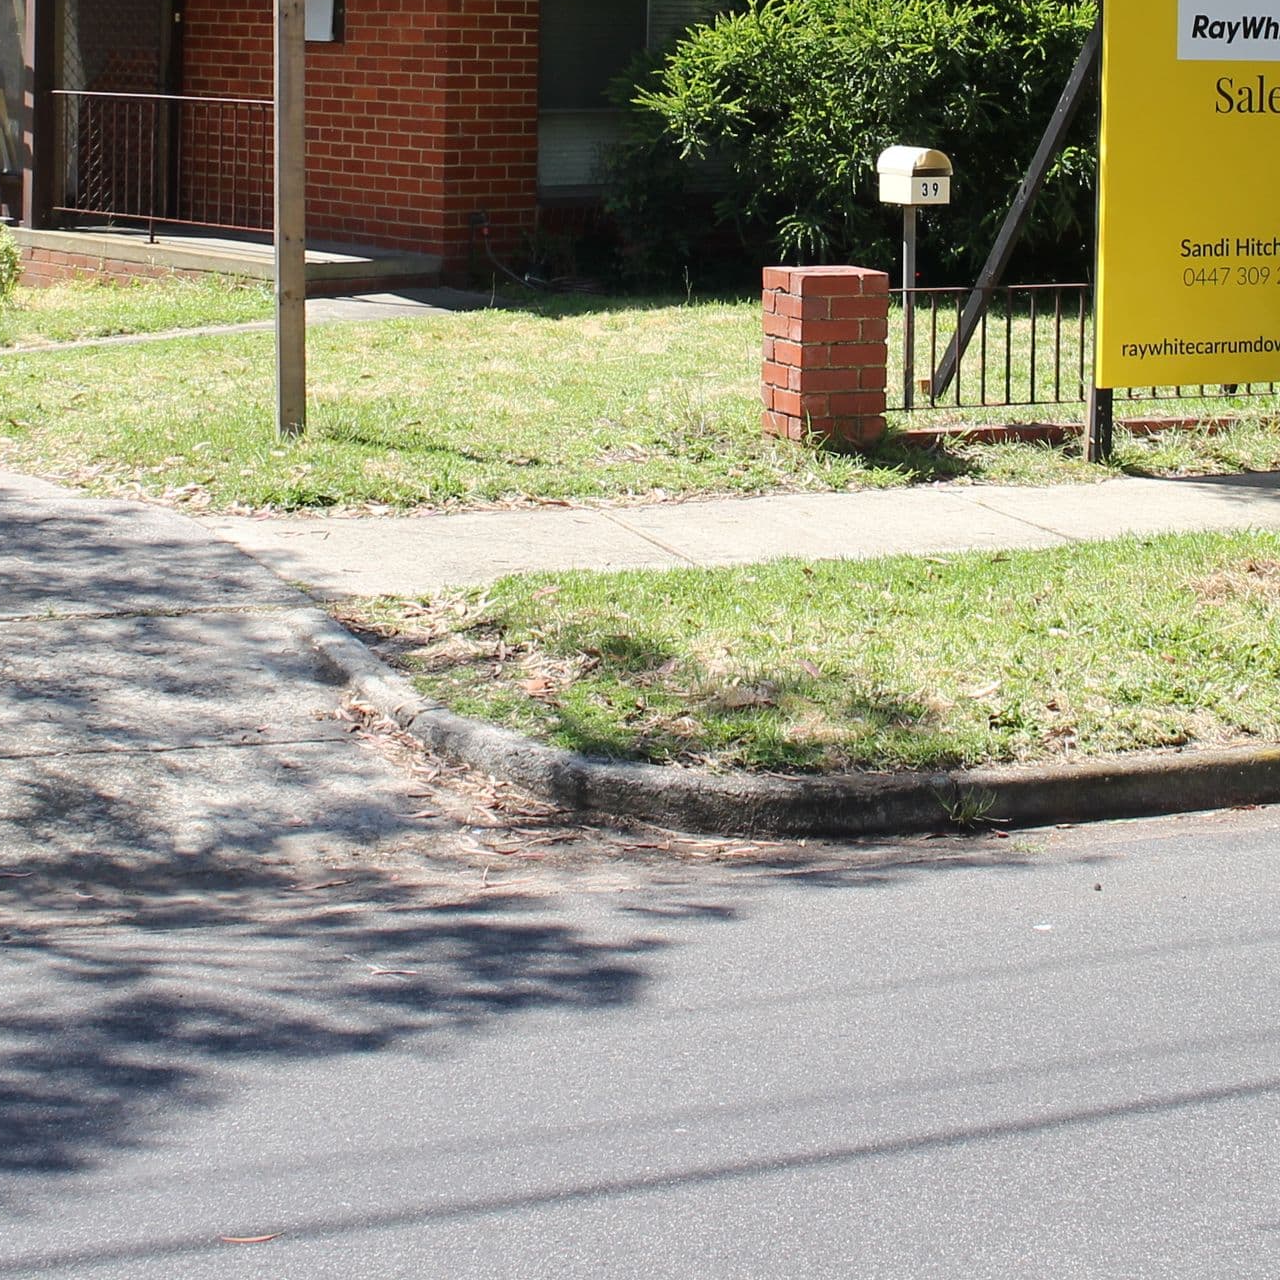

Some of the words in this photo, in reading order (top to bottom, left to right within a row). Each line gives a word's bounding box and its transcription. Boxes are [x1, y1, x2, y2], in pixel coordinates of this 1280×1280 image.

[921, 182, 939, 197] 39
[1180, 238, 1230, 257] Sandi
[1183, 267, 1231, 287] 0447
[1236, 266, 1271, 286] 309
